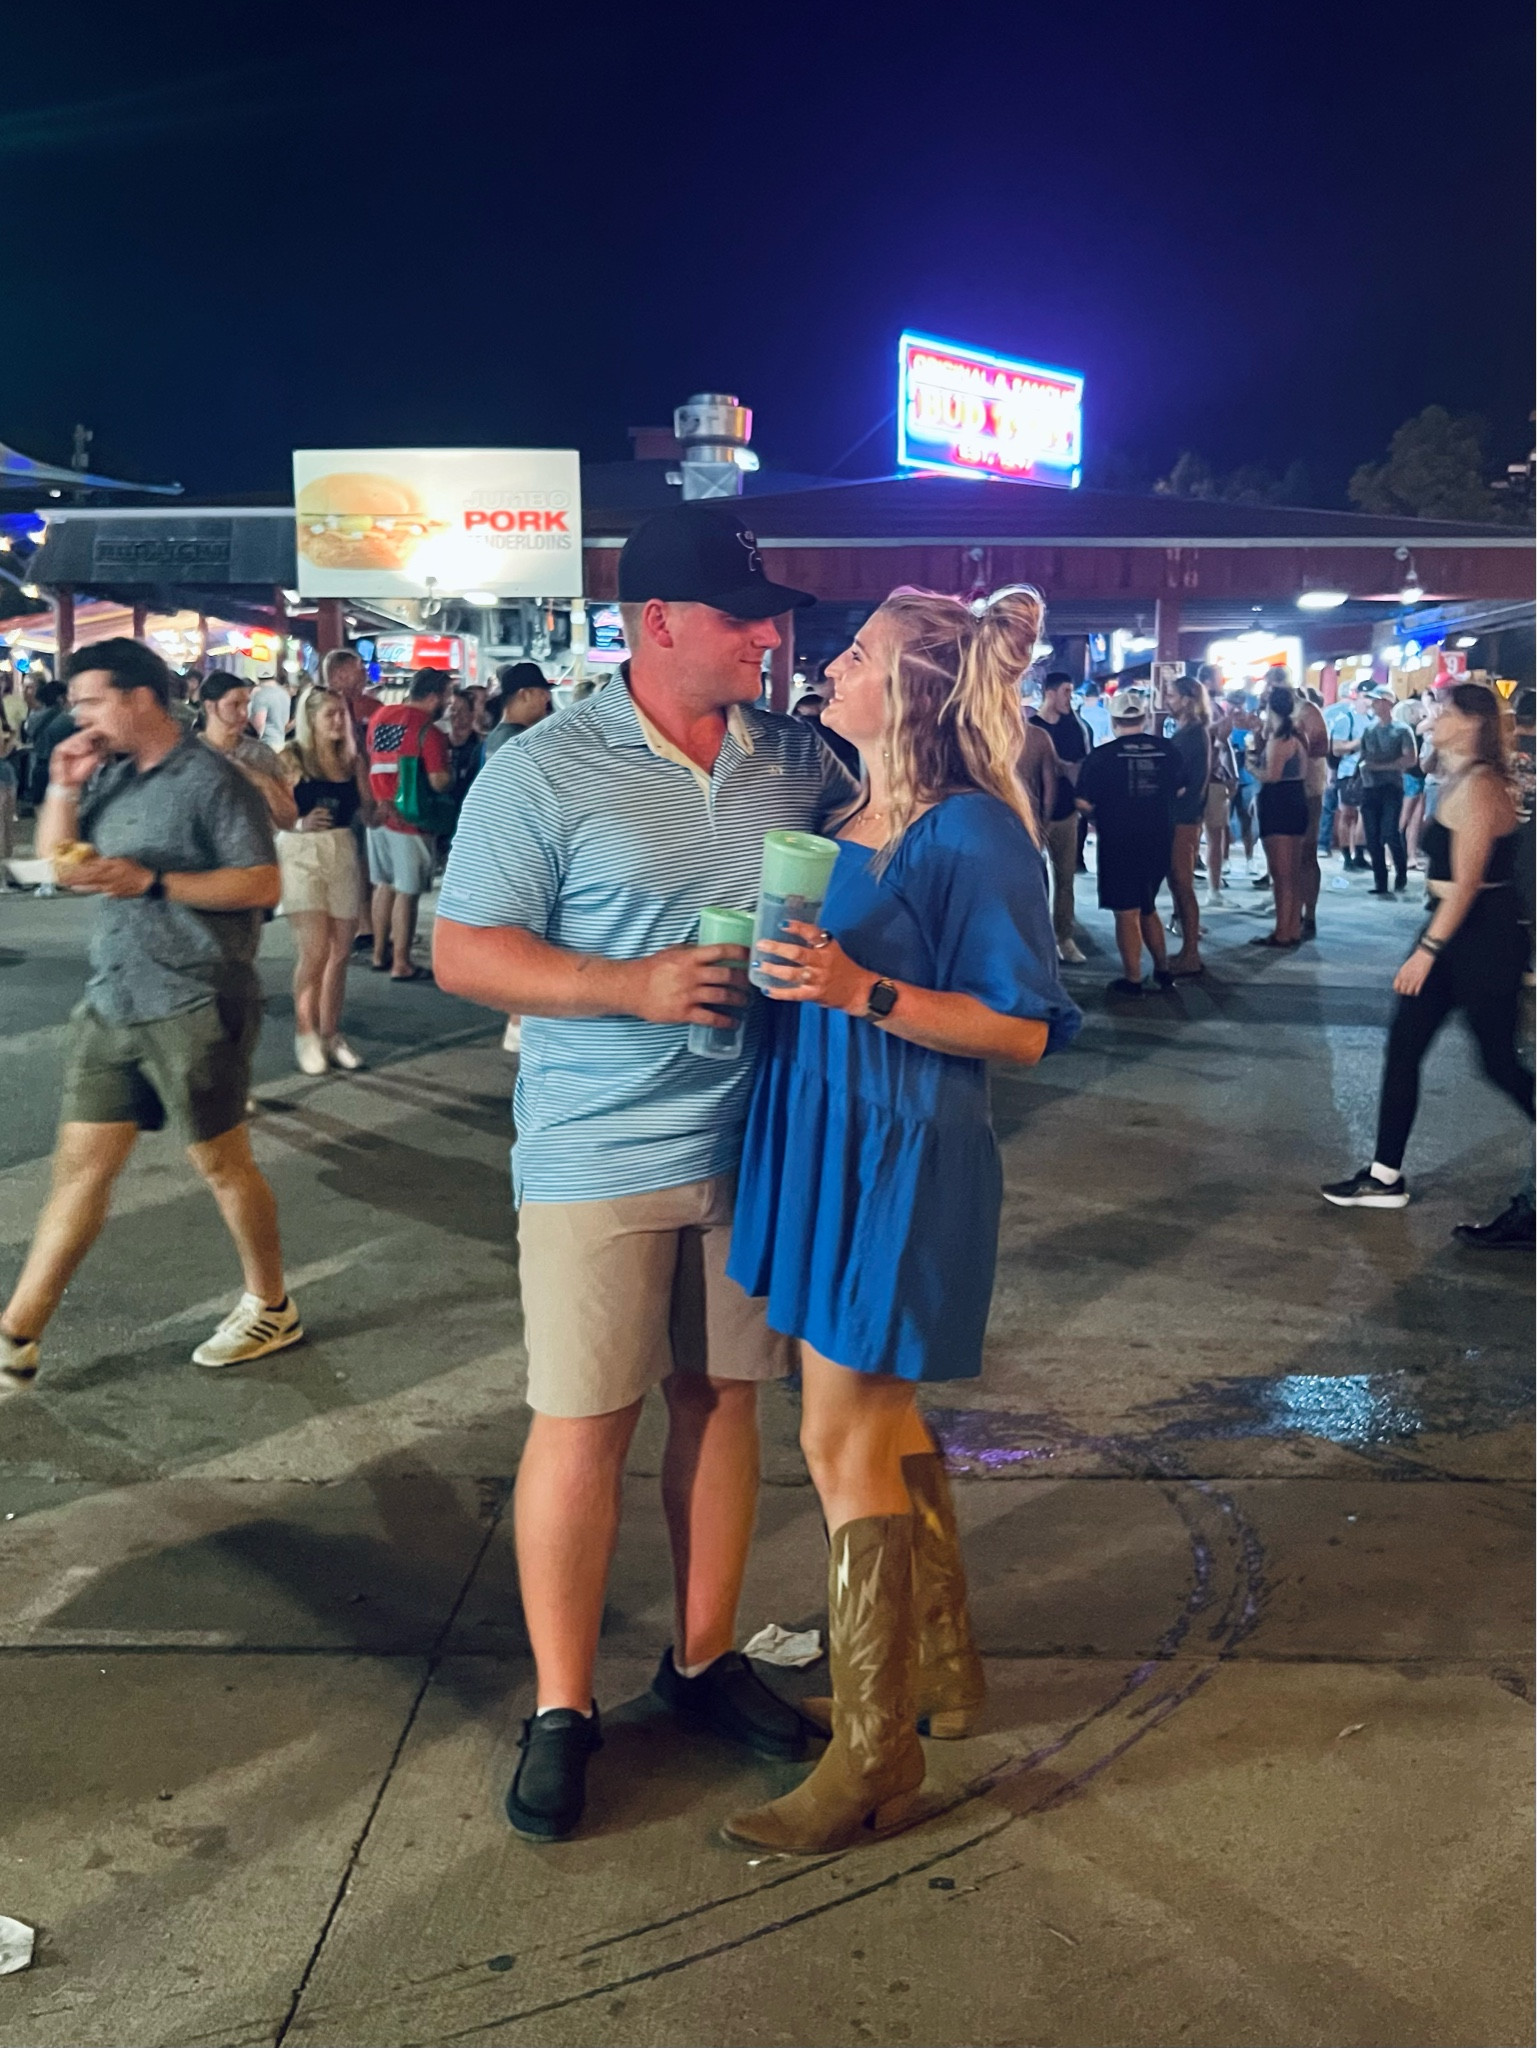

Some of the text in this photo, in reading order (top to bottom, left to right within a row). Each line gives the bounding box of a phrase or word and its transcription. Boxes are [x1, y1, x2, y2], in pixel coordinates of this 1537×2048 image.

[464, 490, 571, 508] JUMBO
[464, 510, 569, 532] PORK
[465, 535, 571, 550] NDERLOINS
